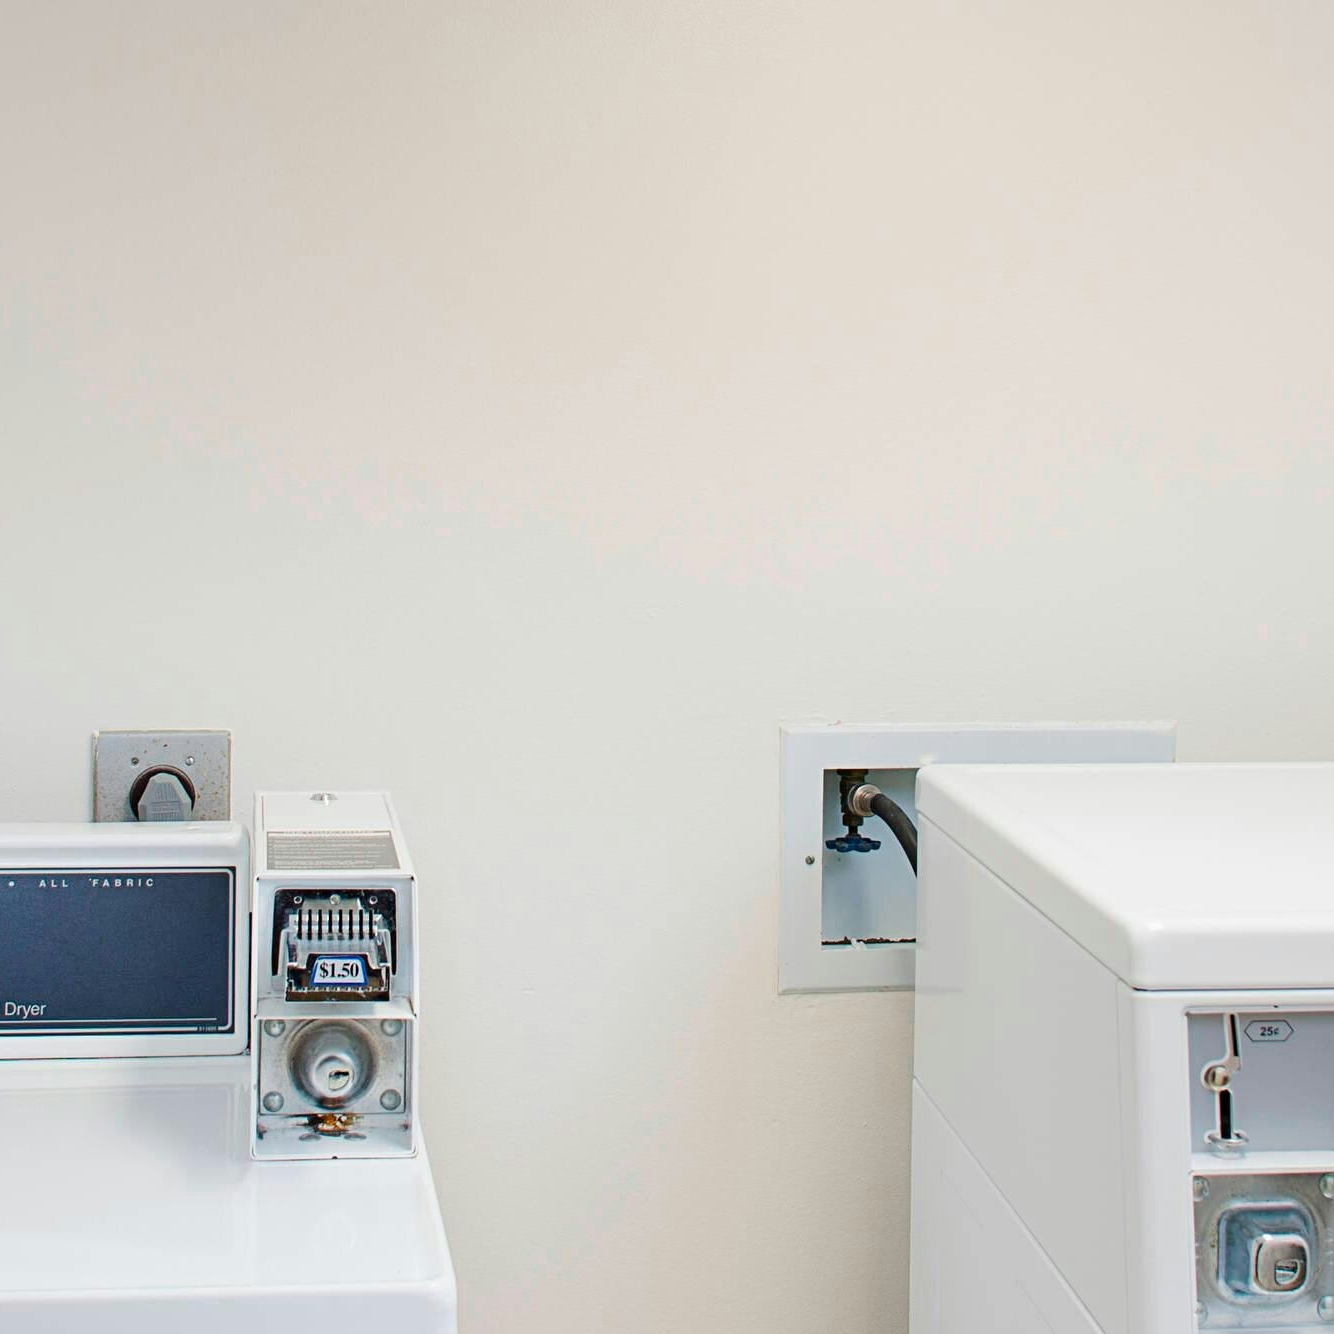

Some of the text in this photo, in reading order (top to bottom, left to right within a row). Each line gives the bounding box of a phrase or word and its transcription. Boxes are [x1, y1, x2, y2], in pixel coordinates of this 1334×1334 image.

[39, 878, 69, 888] ALL
[92, 878, 155, 887] FABRIC
[319, 960, 359, 980] $1.50
[5, 1000, 47, 1019] Dryer
